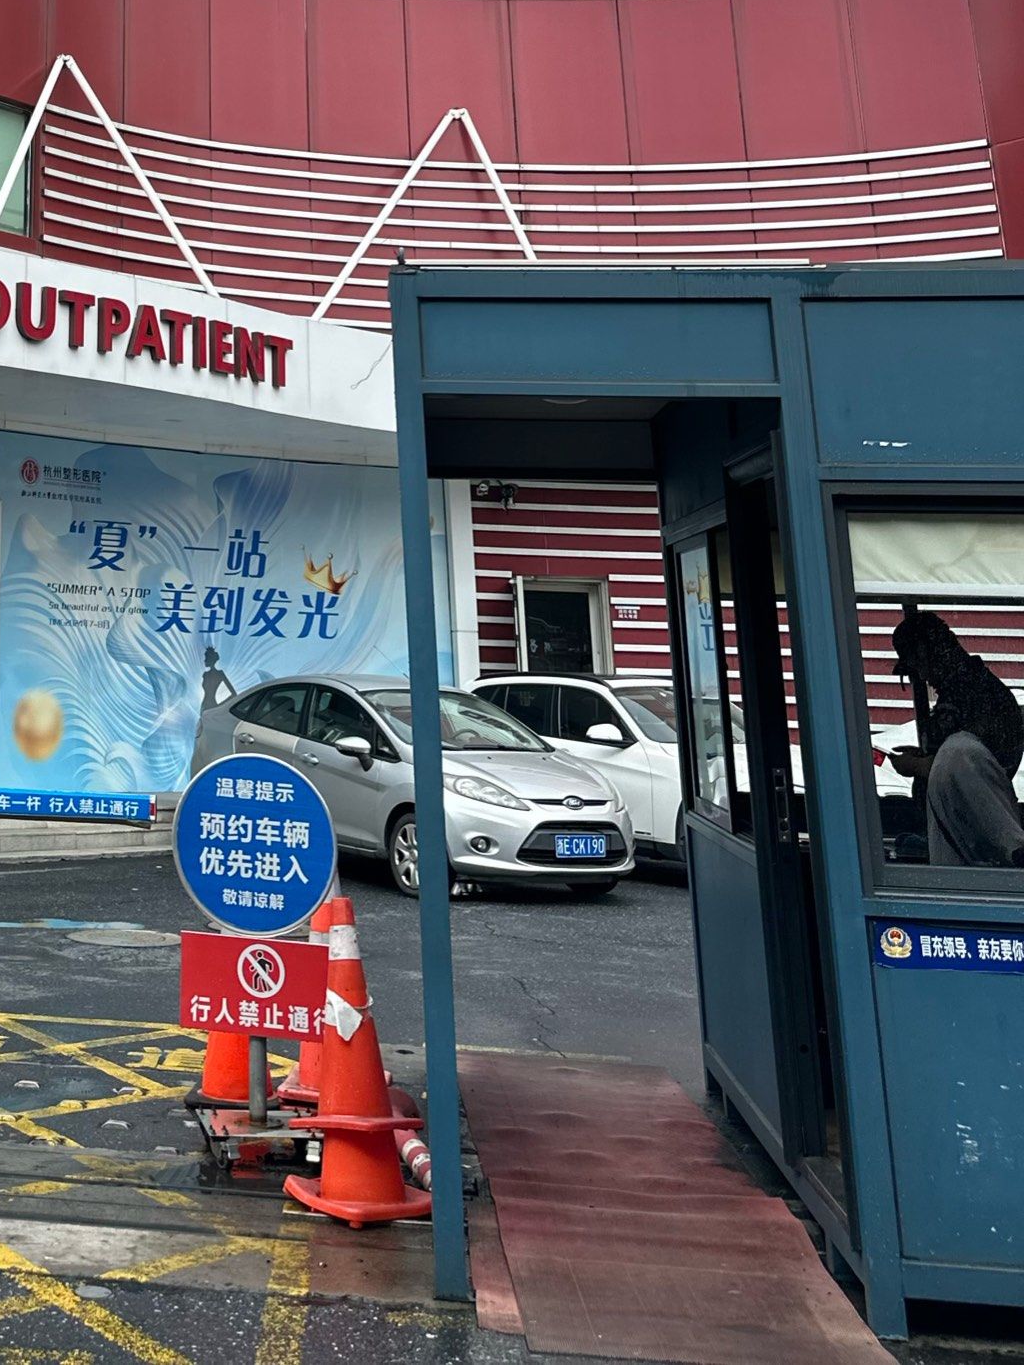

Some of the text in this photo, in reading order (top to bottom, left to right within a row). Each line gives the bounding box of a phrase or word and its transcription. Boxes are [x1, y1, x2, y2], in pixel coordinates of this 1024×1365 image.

[42, 464, 102, 484] 杭州整形医院
[106, 586, 116, 597] A
[120, 587, 151, 598] STOP
[61, 601, 99, 612] beautiful
[101, 605, 113, 613] as
[115, 605, 125, 613] to
[128, 605, 149, 615] glow
[154, 581, 341, 641] 美到发光
[216, 777, 295, 803] 温馨提示
[49, 795, 140, 817] 行人禁止通行
[199, 812, 311, 850] 预约车辆
[199, 846, 310, 885] 优先进入
[222, 888, 285, 911] 敬请谅解
